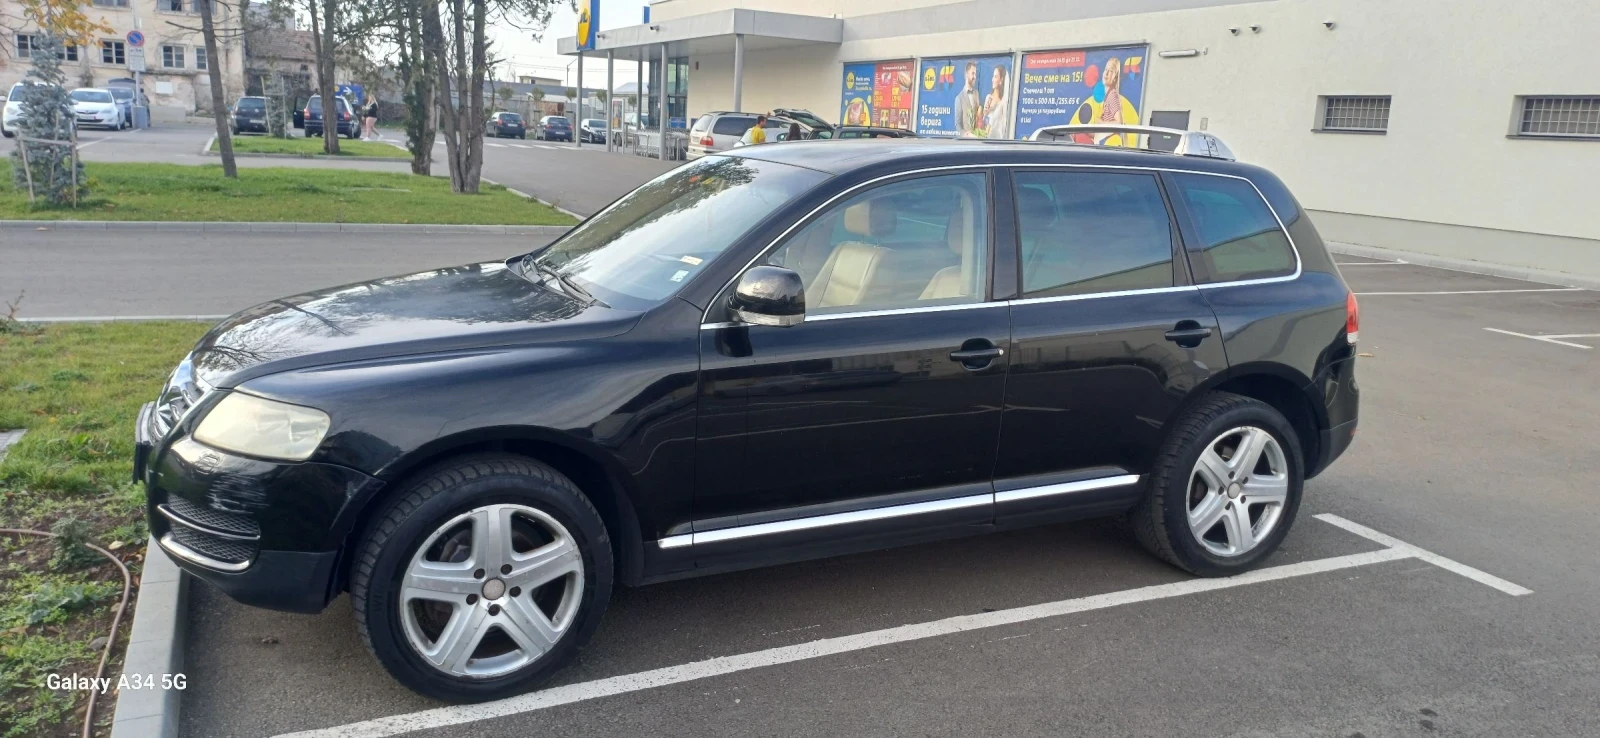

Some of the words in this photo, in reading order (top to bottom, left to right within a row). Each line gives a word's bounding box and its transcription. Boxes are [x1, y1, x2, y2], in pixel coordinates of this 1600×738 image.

[1024, 73, 1043, 84] Вече
[1043, 74, 1059, 83] сме
[1060, 74, 1070, 83] на
[1071, 71, 1084, 83] 15!
[1022, 97, 1034, 105] 1000
[1038, 97, 1048, 105] 500
[921, 104, 928, 115] 15
[928, 106, 951, 117] години
[920, 116, 942, 128] верига
